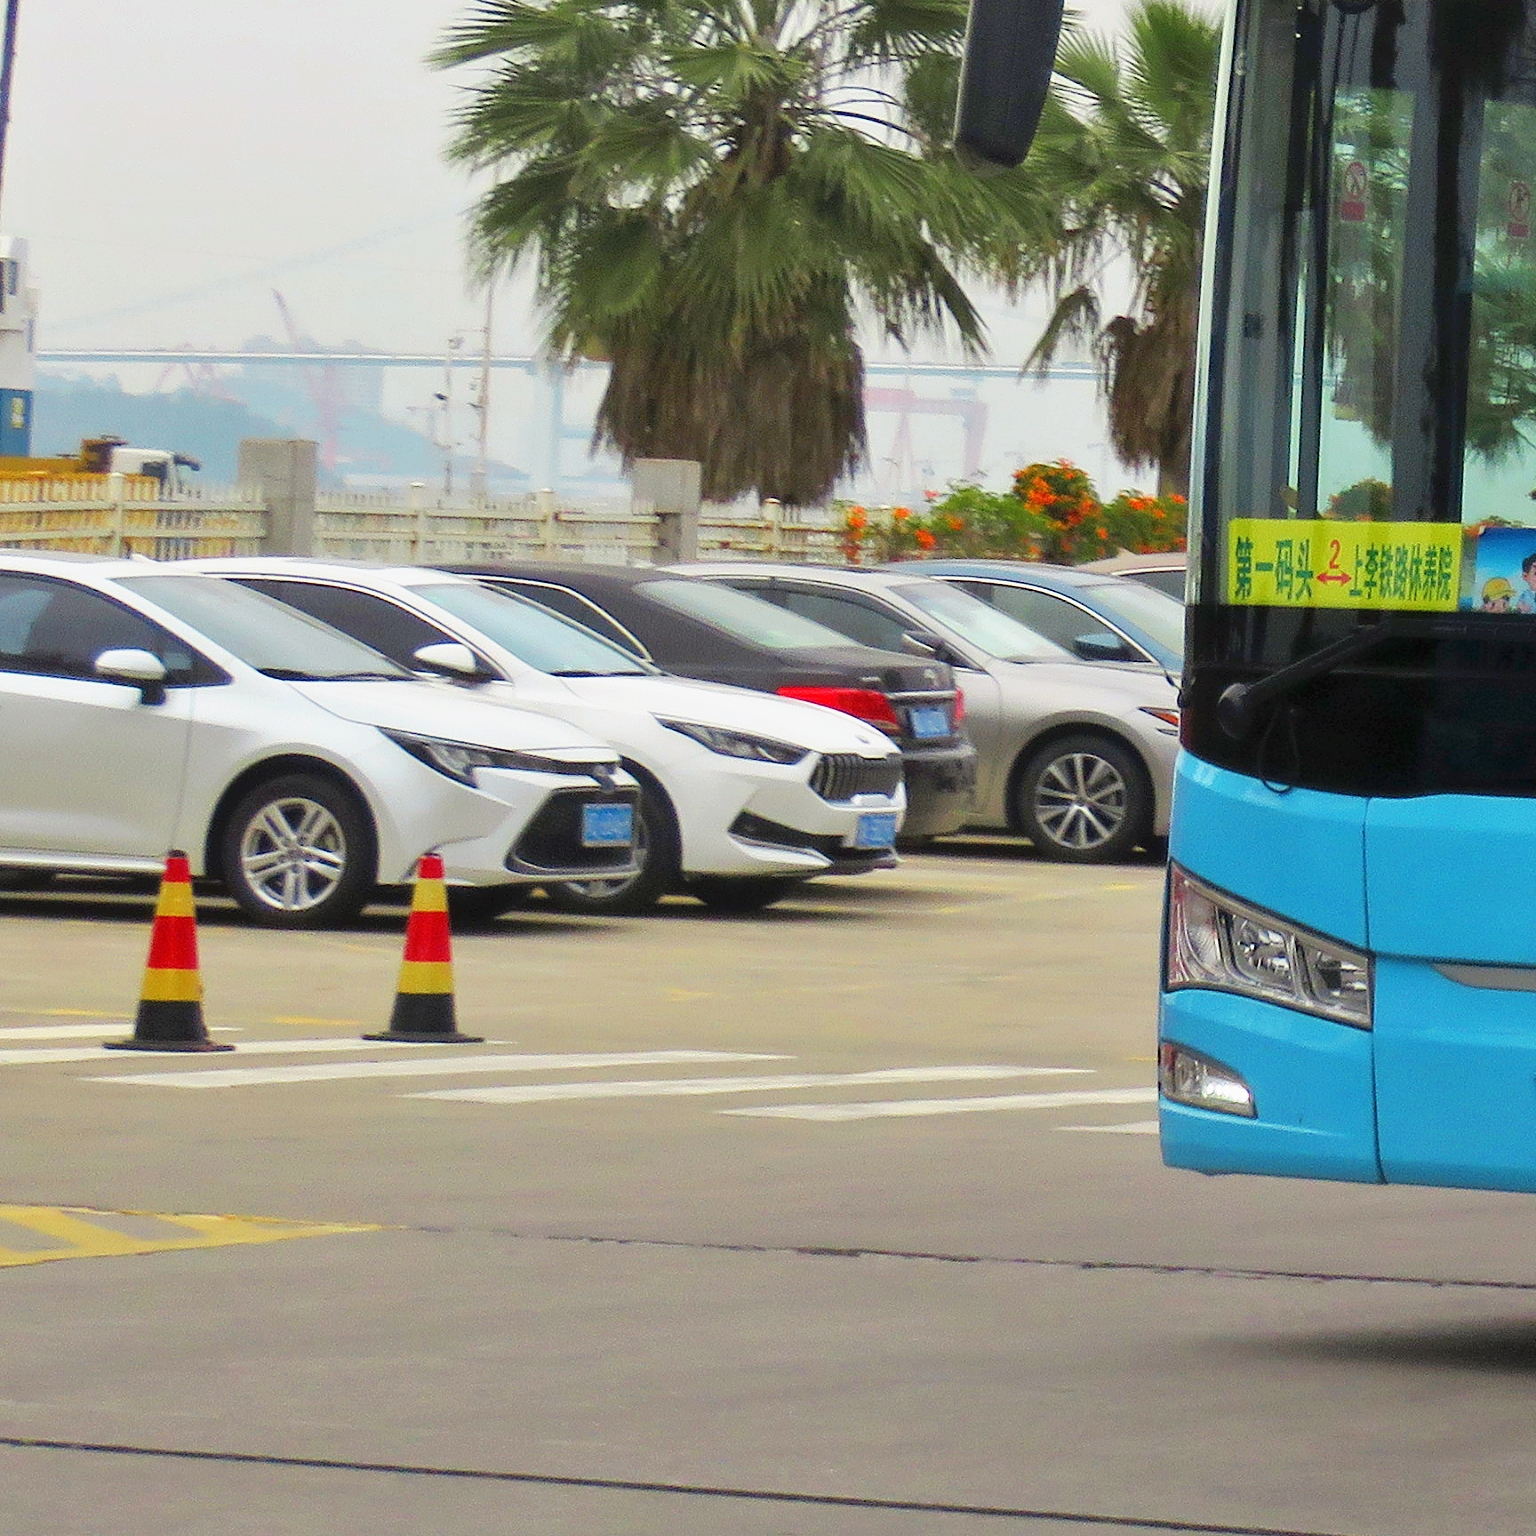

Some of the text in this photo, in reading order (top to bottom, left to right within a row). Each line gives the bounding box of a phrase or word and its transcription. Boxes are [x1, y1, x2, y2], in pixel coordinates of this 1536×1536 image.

[1234, 536, 1314, 600] 第一码头
[1349, 543, 1453, 600] 上李铁路休养院
